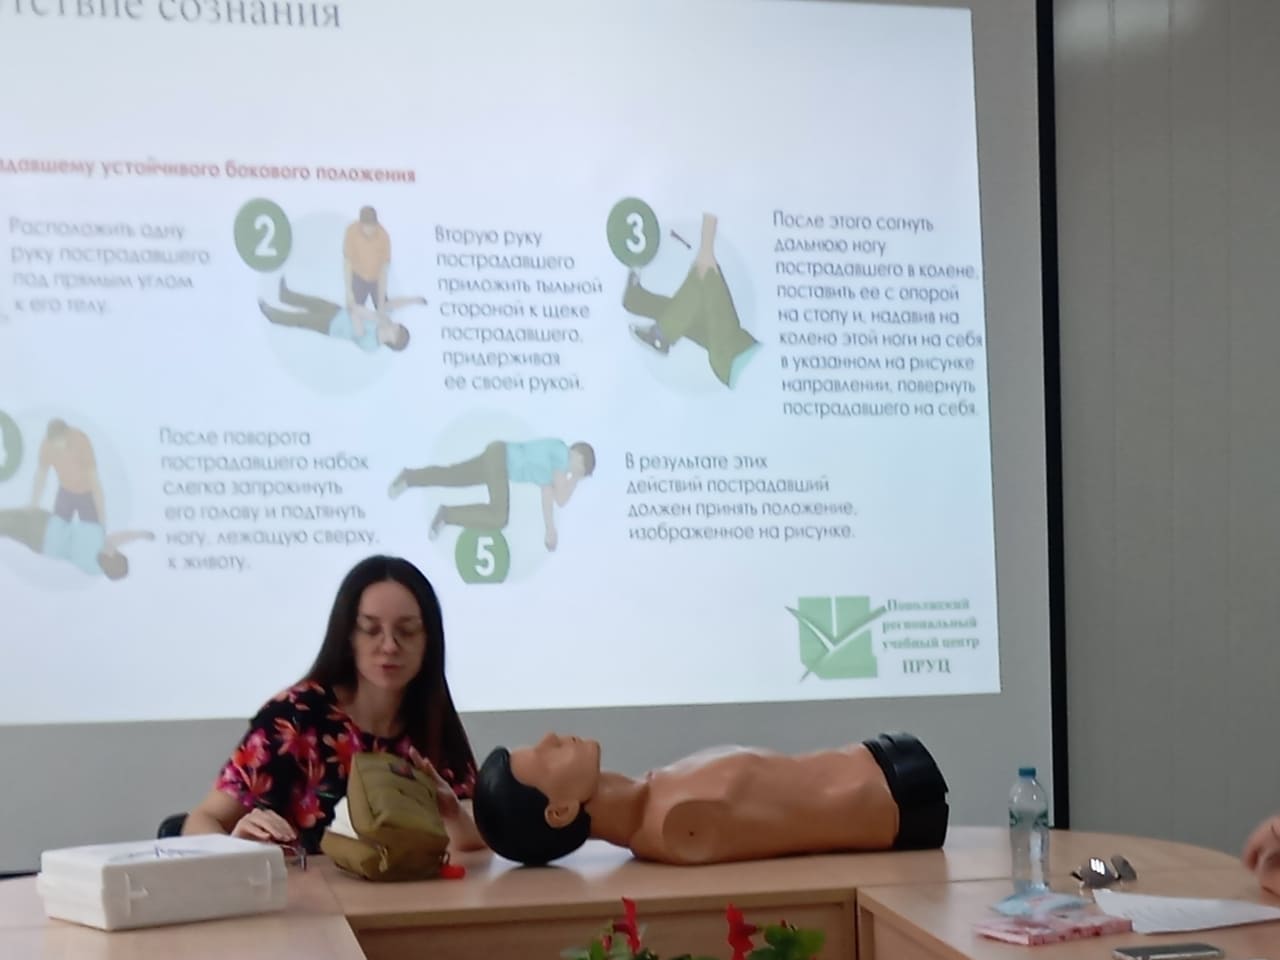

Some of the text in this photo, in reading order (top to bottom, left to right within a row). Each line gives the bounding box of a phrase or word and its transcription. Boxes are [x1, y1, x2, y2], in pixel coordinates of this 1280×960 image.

[0, 0, 341, 28] тствие сознания
[103, 156, 220, 178] устойчивого
[225, 160, 310, 181] бокового
[315, 166, 416, 183] положения
[773, 210, 934, 234] После этого согнуть
[254, 215, 277, 257] 2
[435, 225, 542, 247] Вторую руку
[625, 212, 647, 253] 3
[774, 238, 886, 256] дальнюю ногу
[437, 252, 575, 271] пострадавшего
[776, 261, 903, 278] пострадавшего
[908, 264, 915, 277] в
[438, 277, 602, 294] приложить тыльной
[777, 284, 959, 304] поставить ее с опорой
[440, 300, 590, 319] стороной к щеке
[778, 308, 799, 322] на
[804, 309, 847, 325] стопу
[871, 310, 935, 325] надавив
[939, 311, 959, 324] на
[779, 330, 983, 347] колено этой ноги на себя
[443, 350, 560, 368] придерживая
[781, 355, 974, 372] в указанном на рисунке
[444, 376, 466, 390] ее
[471, 373, 524, 390] своей
[897, 379, 976, 395] повернуть
[783, 401, 909, 418] пострадавшего
[914, 402, 933, 415] на
[160, 427, 311, 447] После поворота
[161, 451, 369, 472] пострадавшего набок
[625, 452, 768, 472] В результате этих
[627, 475, 829, 494] действий пострадавший
[165, 505, 195, 520] его
[201, 505, 259, 522] голову
[265, 505, 275, 519] и
[628, 500, 691, 517] должен
[696, 500, 757, 518] принять
[217, 531, 308, 548] лежащую
[629, 522, 754, 543] изображенное
[759, 525, 779, 540] на
[168, 556, 177, 570] к
[474, 535, 496, 577] 5
[902, 658, 951, 674] ПРУЦ
